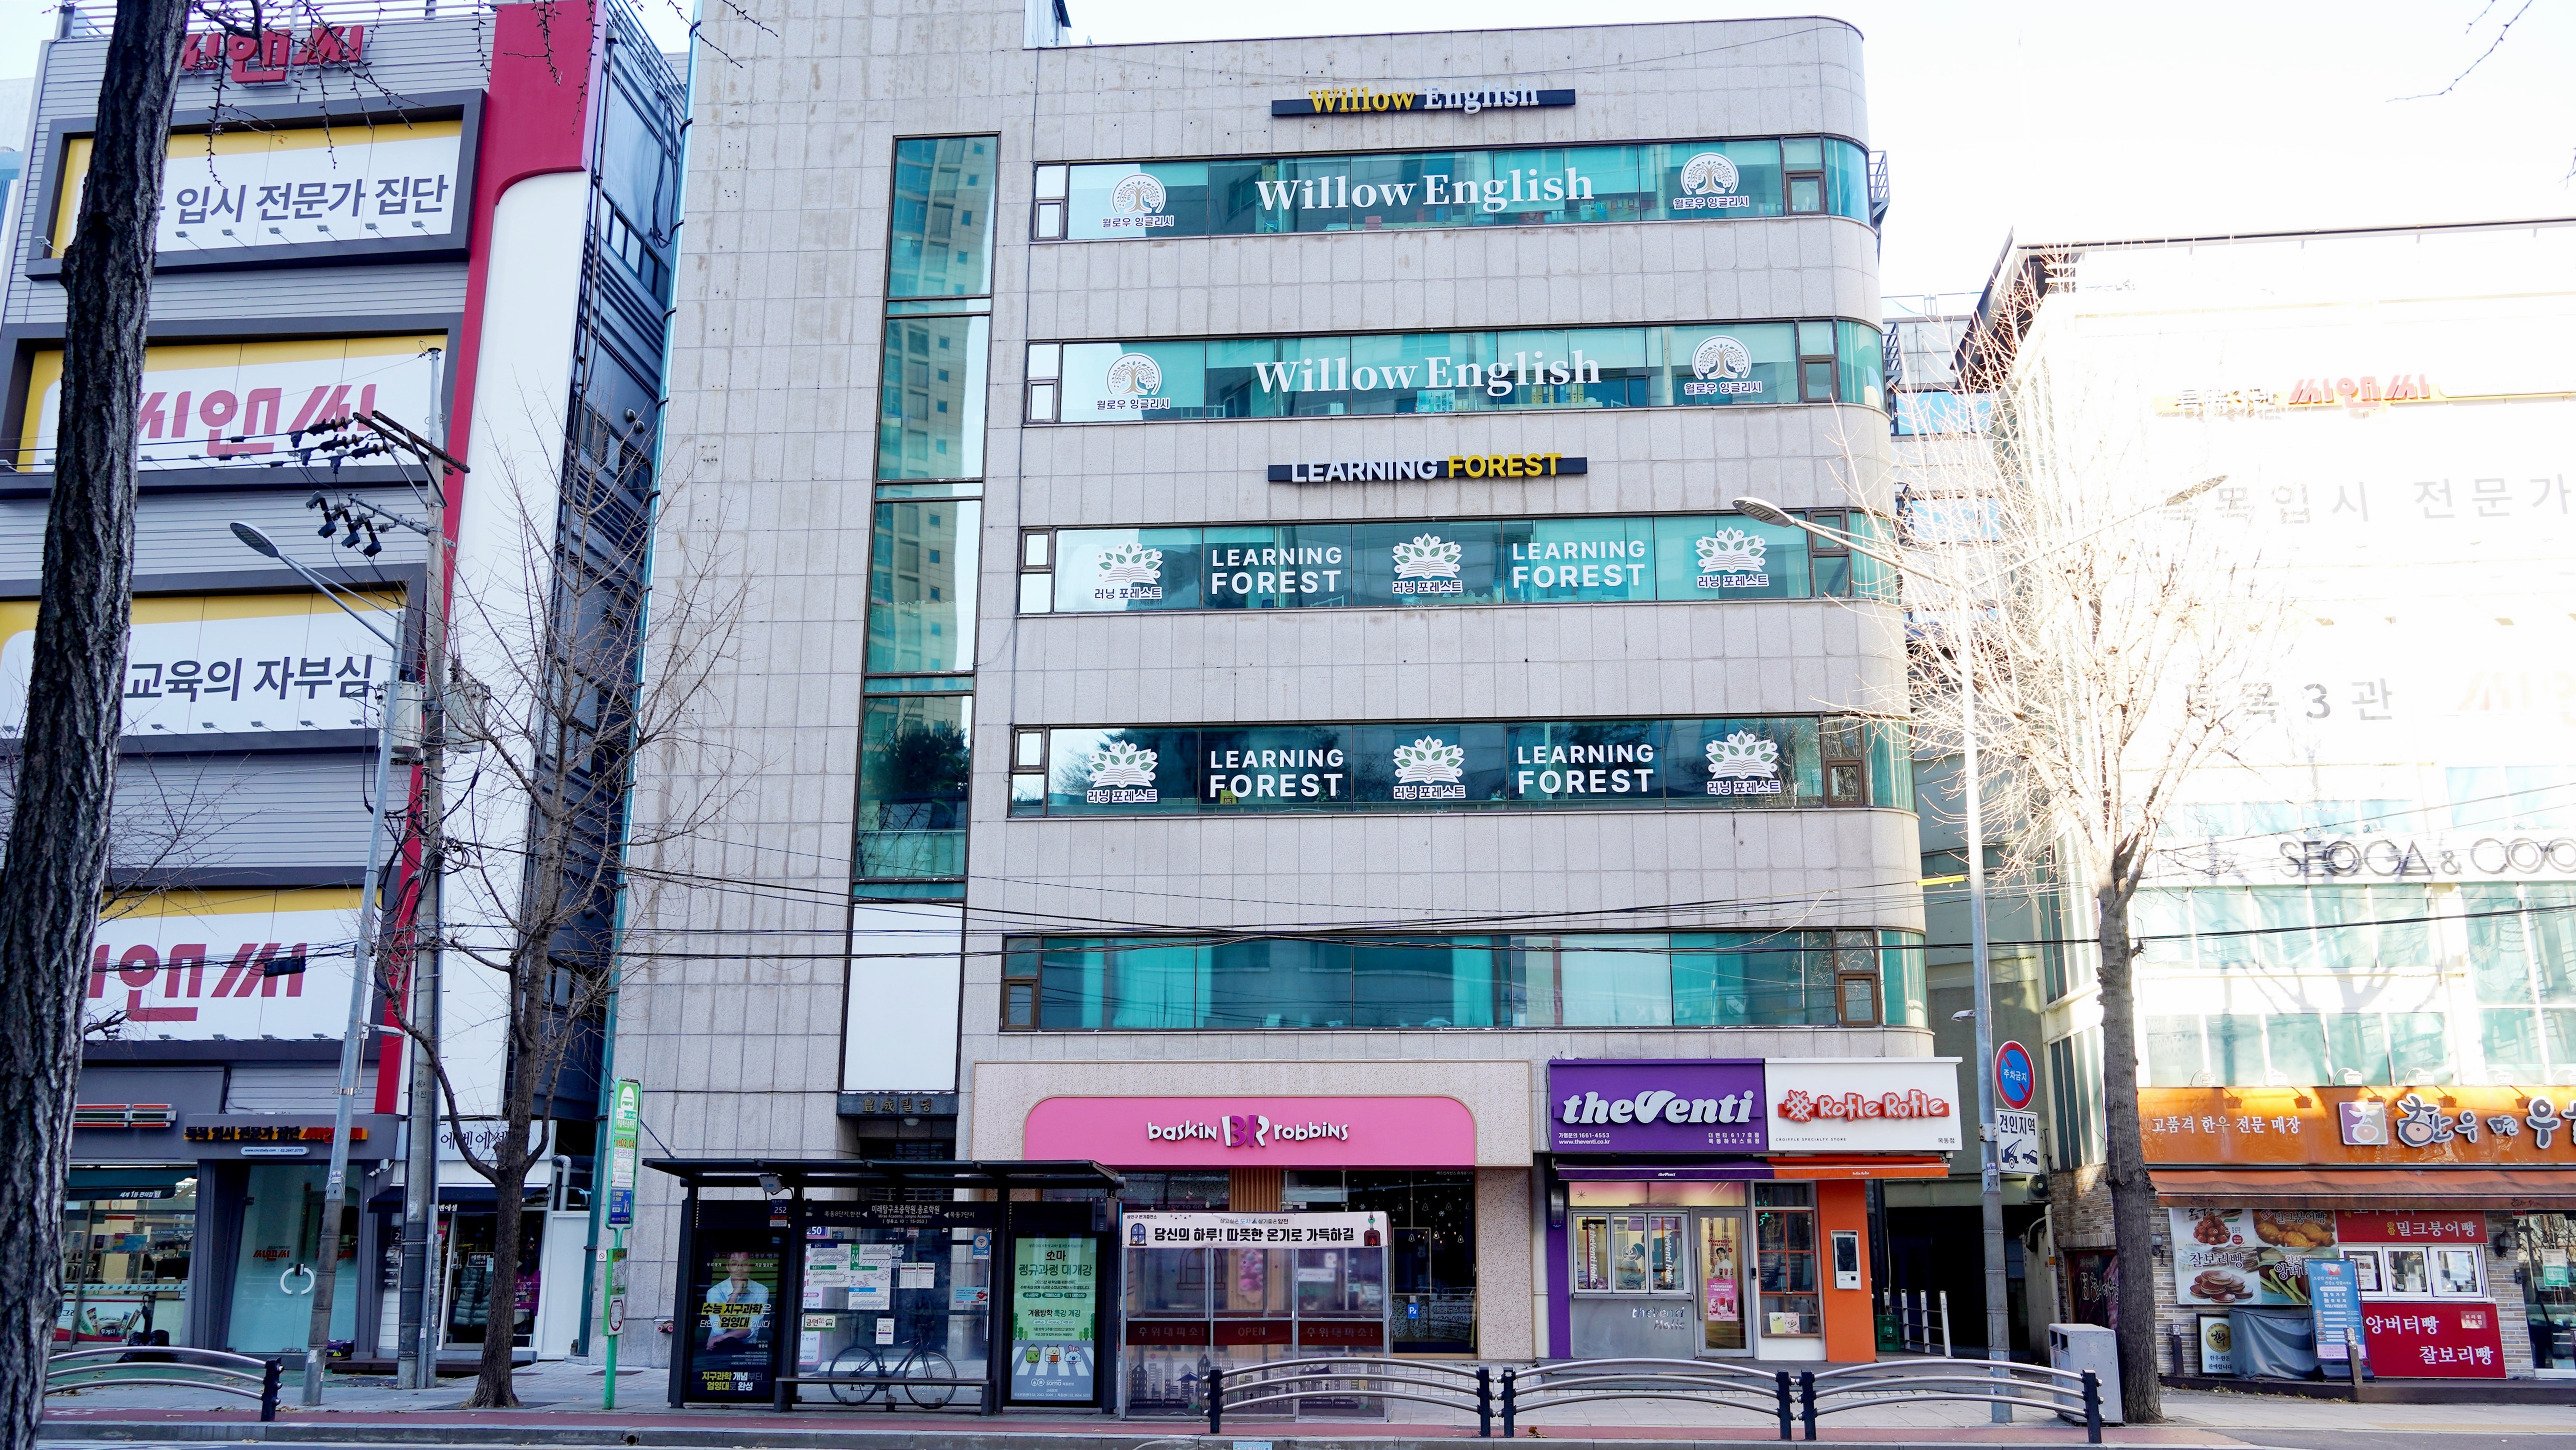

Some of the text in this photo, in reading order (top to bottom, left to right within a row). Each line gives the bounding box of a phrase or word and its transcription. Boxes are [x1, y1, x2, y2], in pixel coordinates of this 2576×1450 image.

[1309, 81, 1540, 115] Willow English
[1255, 166, 1594, 213] Willow English
[176, 174, 449, 225] 입시 전문가 집단
[1673, 195, 1750, 211] 윌로우 잉글리시
[1102, 214, 1175, 229] 윌로우 잉글리시
[1253, 349, 1602, 397] Willow English
[1684, 380, 1763, 396] 윌로우 잉글리시
[1096, 397, 1170, 411] 윌로우 잉글리시
[1291, 452, 1562, 482] LEARNING FOREST
[2413, 473, 2572, 520] 전문가
[1212, 546, 1342, 566] LEARNING
[1513, 540, 1646, 561] LEARNING
[1212, 570, 1341, 595] FOREST
[1513, 564, 1646, 589] FOREST
[1696, 573, 1769, 589] 러닝 포레스트
[1095, 586, 1163, 599] 러닝 포레스트
[1392, 579, 1463, 595] 러닝 포레스트
[124, 654, 373, 703] 교육의 자부심
[1211, 748, 1344, 768] LEARNING
[1518, 744, 1654, 765] LEARNING
[1210, 773, 1344, 798] FOREST
[1518, 768, 1653, 795] FOREST
[1707, 780, 1782, 796] 러닝 포레스트
[1087, 788, 1159, 804] 러닝 포레스트
[1393, 784, 1466, 801] 러닝 포레스트
[2439, 849, 2463, 876] &
[2003, 1068, 2027, 1083] 주차금지
[1562, 1089, 1754, 1124] theVenti
[1818, 1088, 1946, 1121] Rofle Rofle
[1147, 1114, 1349, 1148] baskin BR robbins
[1999, 1114, 2036, 1136] 견인지역
[2152, 1115, 2300, 1134] 고품격 한우 전문 매장
[2274, 1211, 2327, 1224] 밀크붕어빵
[1154, 1227, 1354, 1242] 당신의 하루! 따뜻한 온기로 가득하길
[2396, 1221, 2477, 1237] 밀크붕어빵
[851, 1254, 859, 1264] 04
[2188, 1251, 2245, 1269] 찰보리빵
[1019, 1264, 1092, 1276] 정규과정 대개강
[703, 1303, 772, 1315] 수능 지구과학은
[1631, 1306, 1685, 1318] theVenti
[720, 1317, 750, 1328] 엄영대
[1654, 1319, 1685, 1330] Holic
[2366, 1315, 2440, 1335] 앙버터빵
[1139, 1327, 1374, 1337] 추위대피소! OPEN 추위대피소!
[2419, 1345, 2494, 1366] 찰보리빵
[702, 1371, 763, 1381] 지구과학 개념부터
[707, 1381, 754, 1391] 엄영대로 완성
